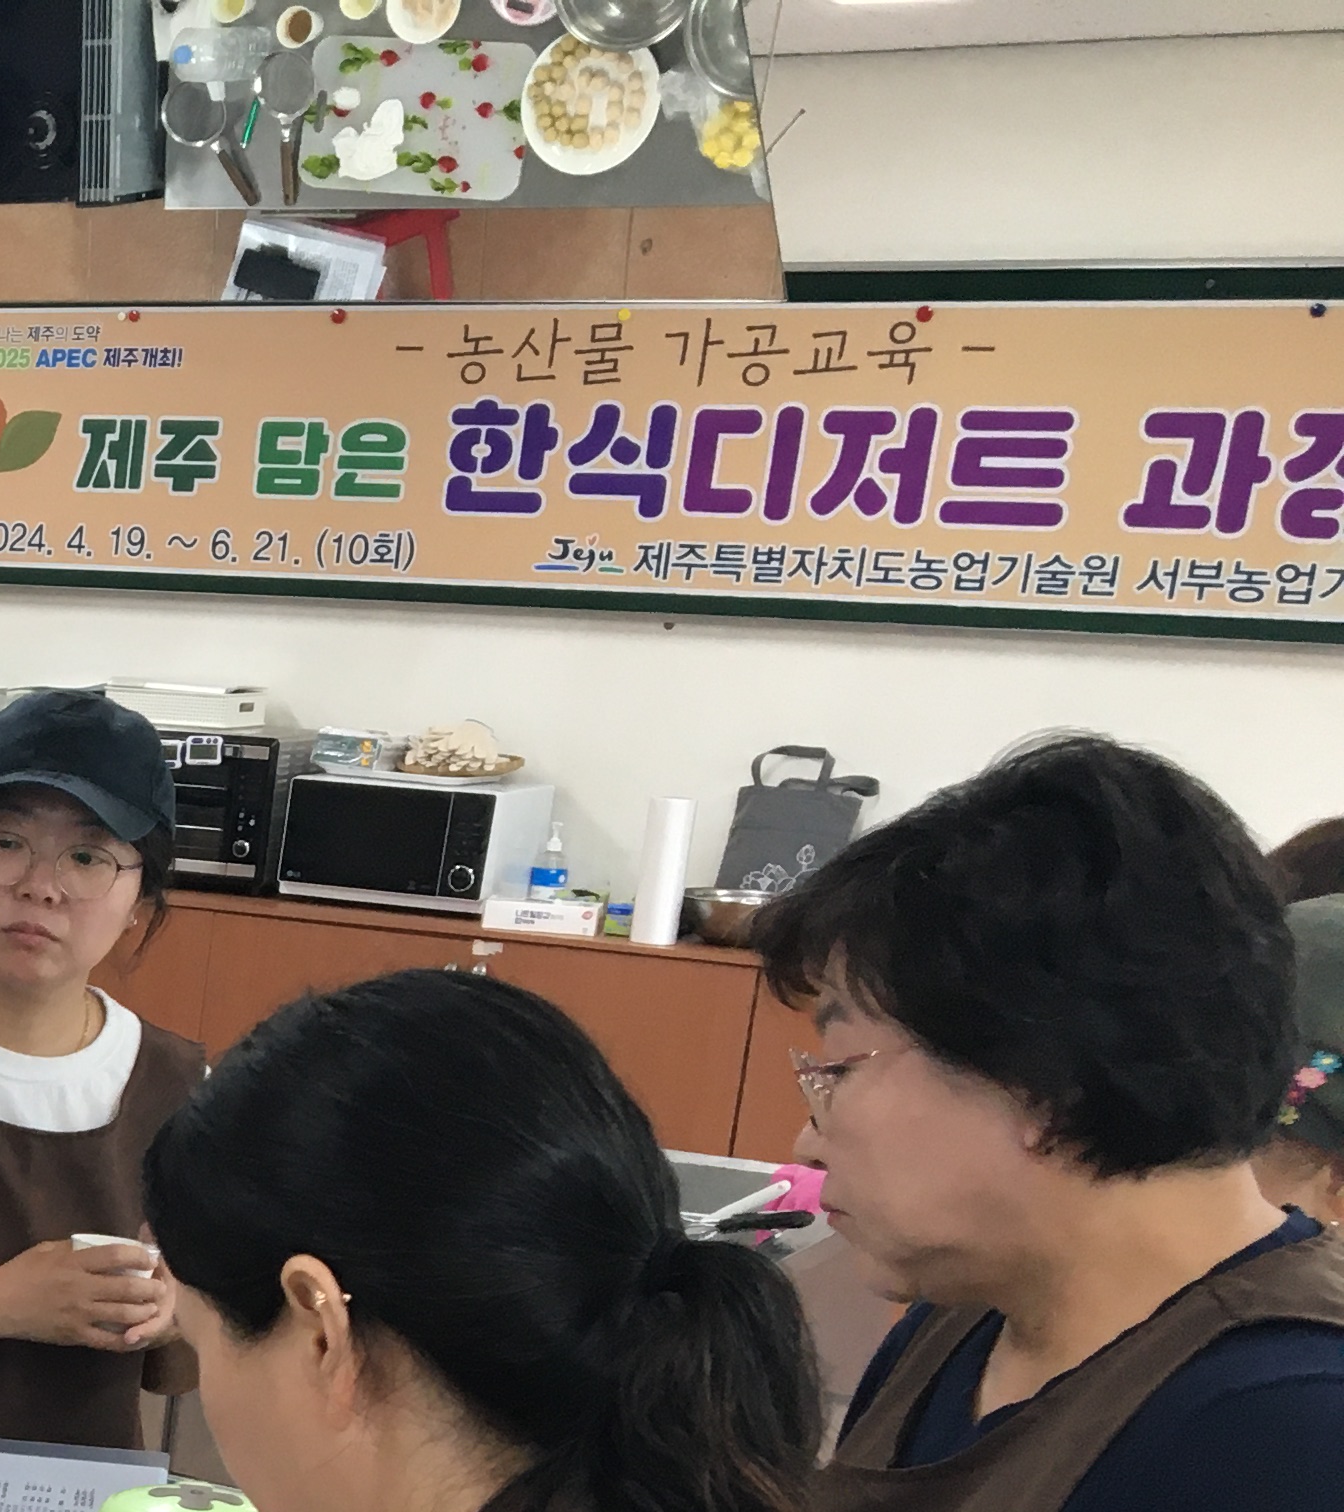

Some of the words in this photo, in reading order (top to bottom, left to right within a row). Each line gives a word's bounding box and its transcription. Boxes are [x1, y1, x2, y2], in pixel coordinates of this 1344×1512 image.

[27, 325, 68, 343] 제주의
[73, 325, 101, 343] 도약
[36, 348, 97, 368] APEC
[446, 318, 634, 385] 농산물
[664, 318, 933, 387] 가공교육
[75, 417, 221, 494] 제주
[255, 419, 408, 499] 담은
[443, 398, 1078, 528] 한식디저트
[67, 524, 93, 558] 4.
[110, 525, 152, 560] 19.
[211, 528, 239, 563] 6.
[252, 530, 301, 565] 21.
[316, 527, 416, 572] (10회)
[547, 538, 614, 573] Jeju
[632, 541, 1120, 597] 제주특별자치도농업기술원
